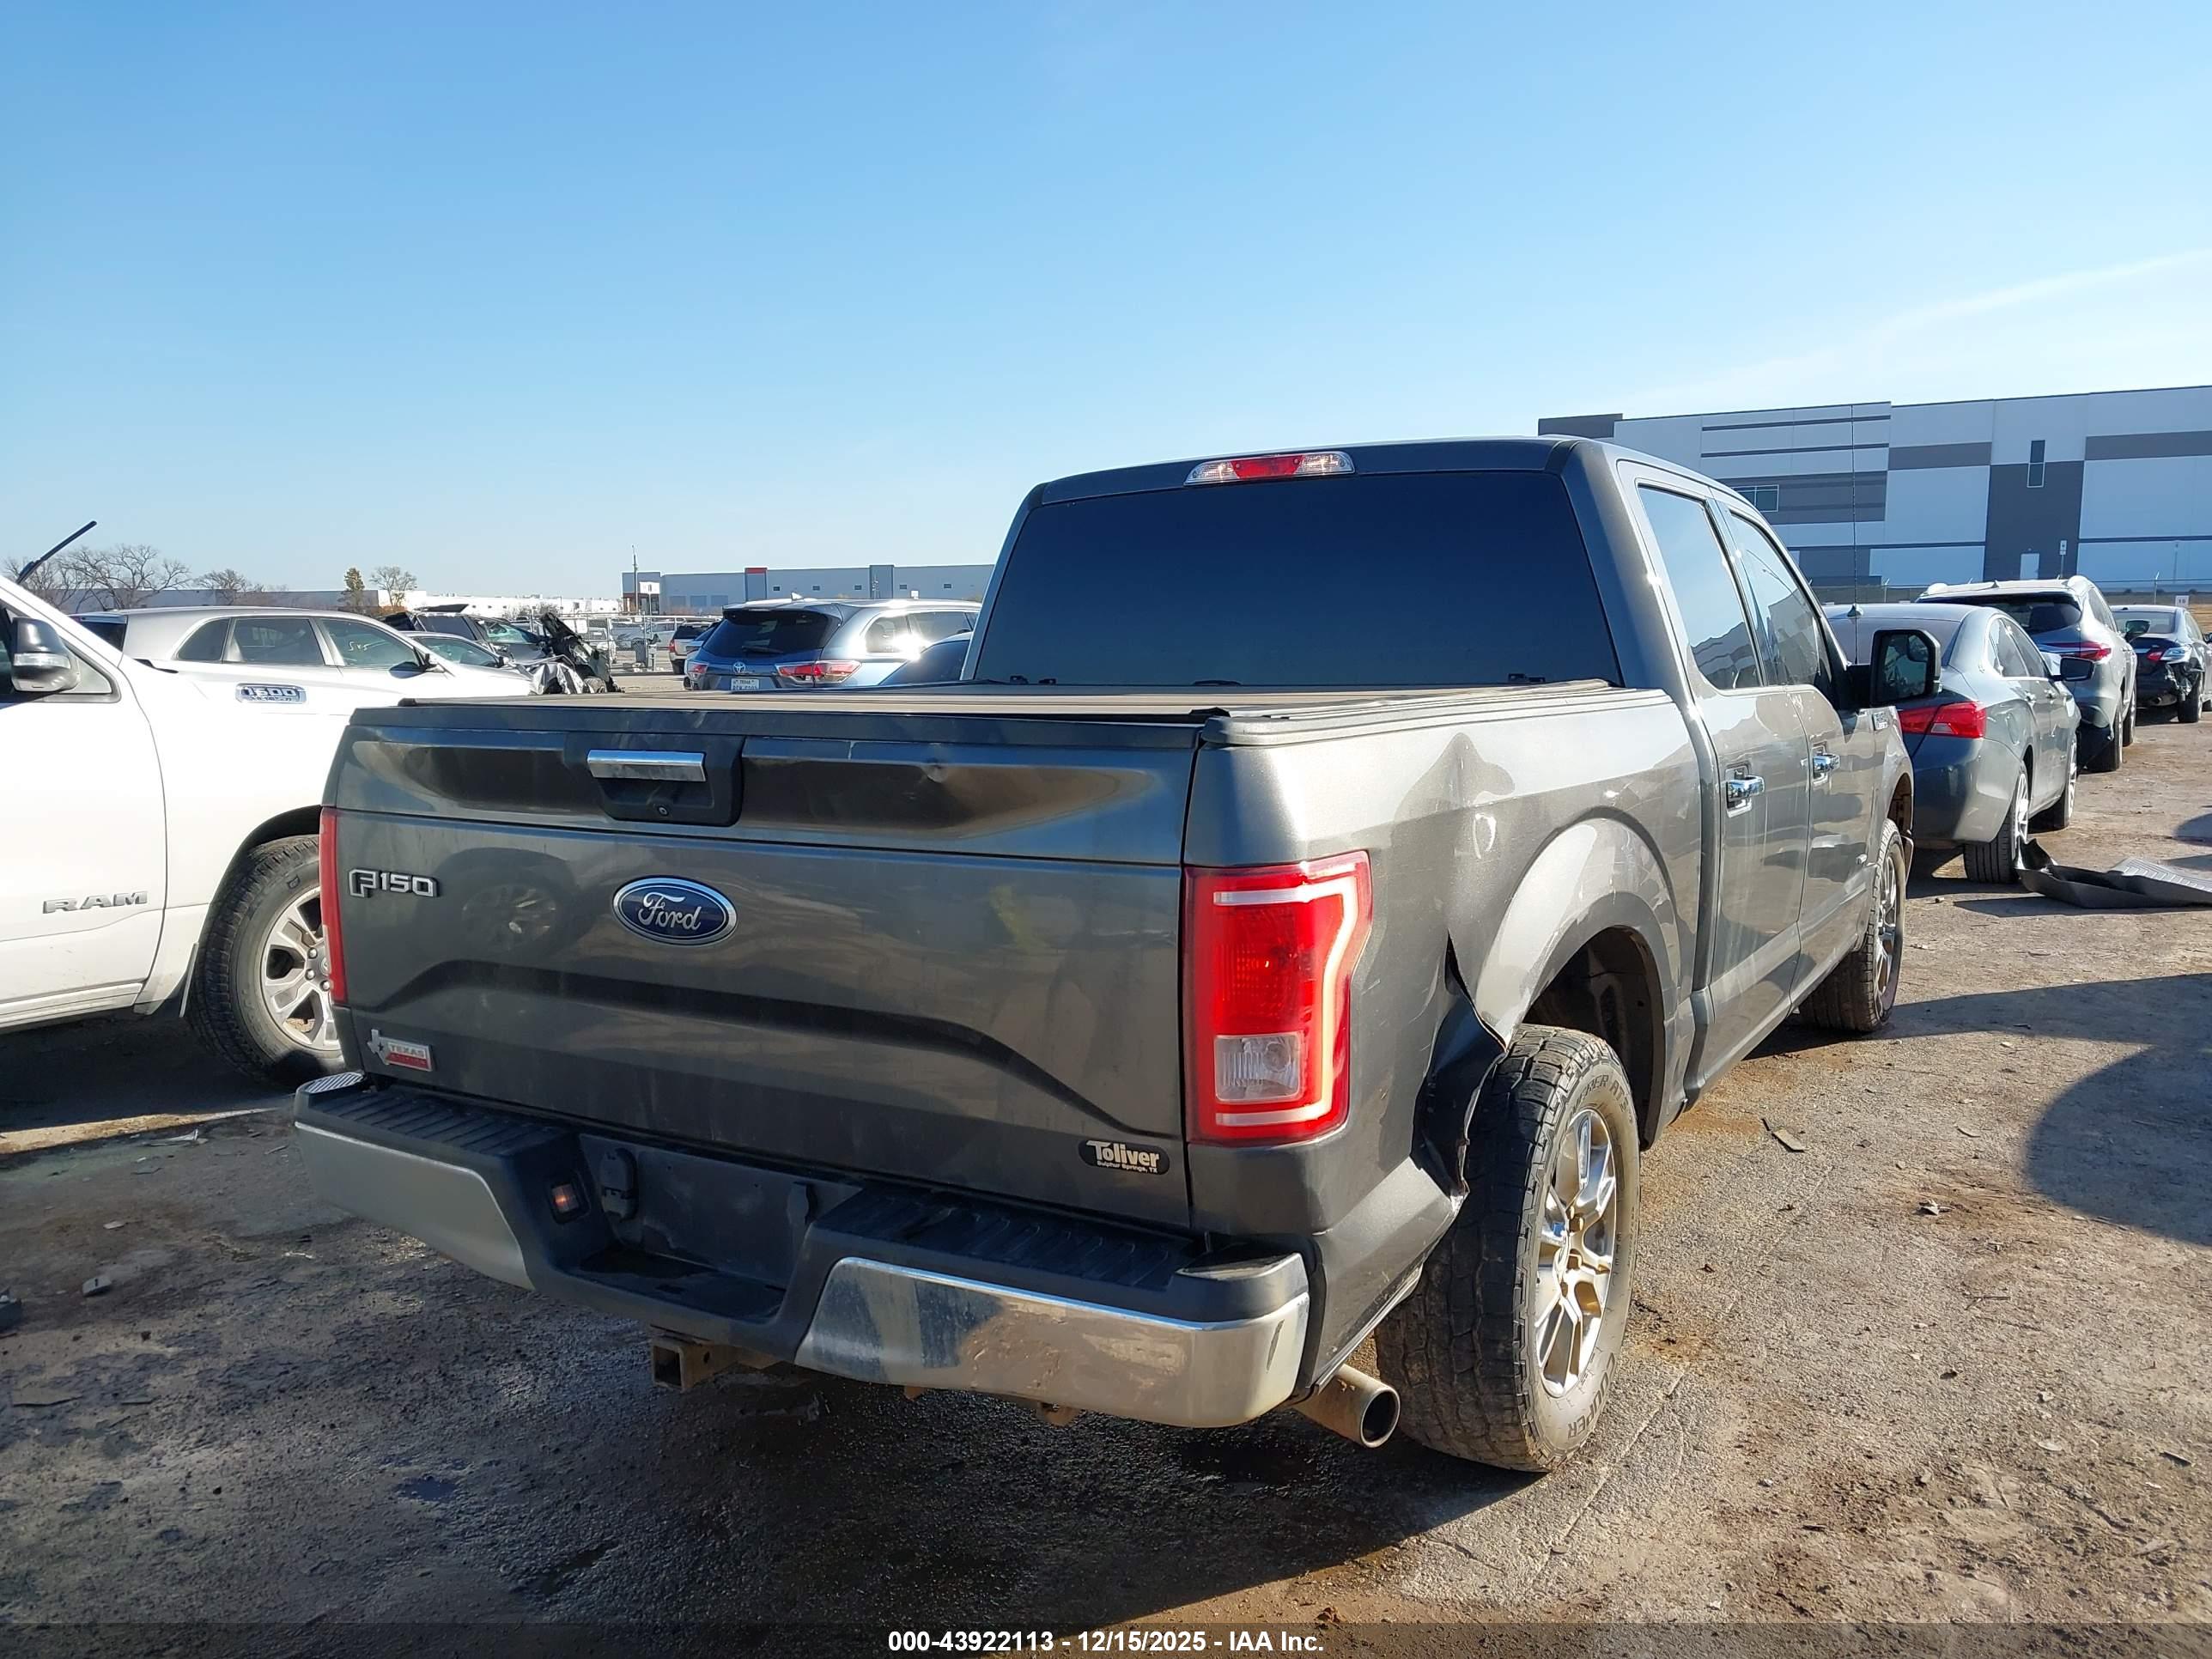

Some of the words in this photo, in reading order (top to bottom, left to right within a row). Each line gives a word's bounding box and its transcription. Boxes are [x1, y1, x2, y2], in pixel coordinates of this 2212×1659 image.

[243, 686, 297, 696] 1500
[42, 890, 148, 915] RAM
[637, 891, 703, 931] Ford
[388, 1043, 427, 1058] TEXAS
[1086, 1139, 1160, 1168] Toliver
[1121, 1164, 1148, 1173] Springs,
[1567, 1352, 1615, 1439] COOPER
